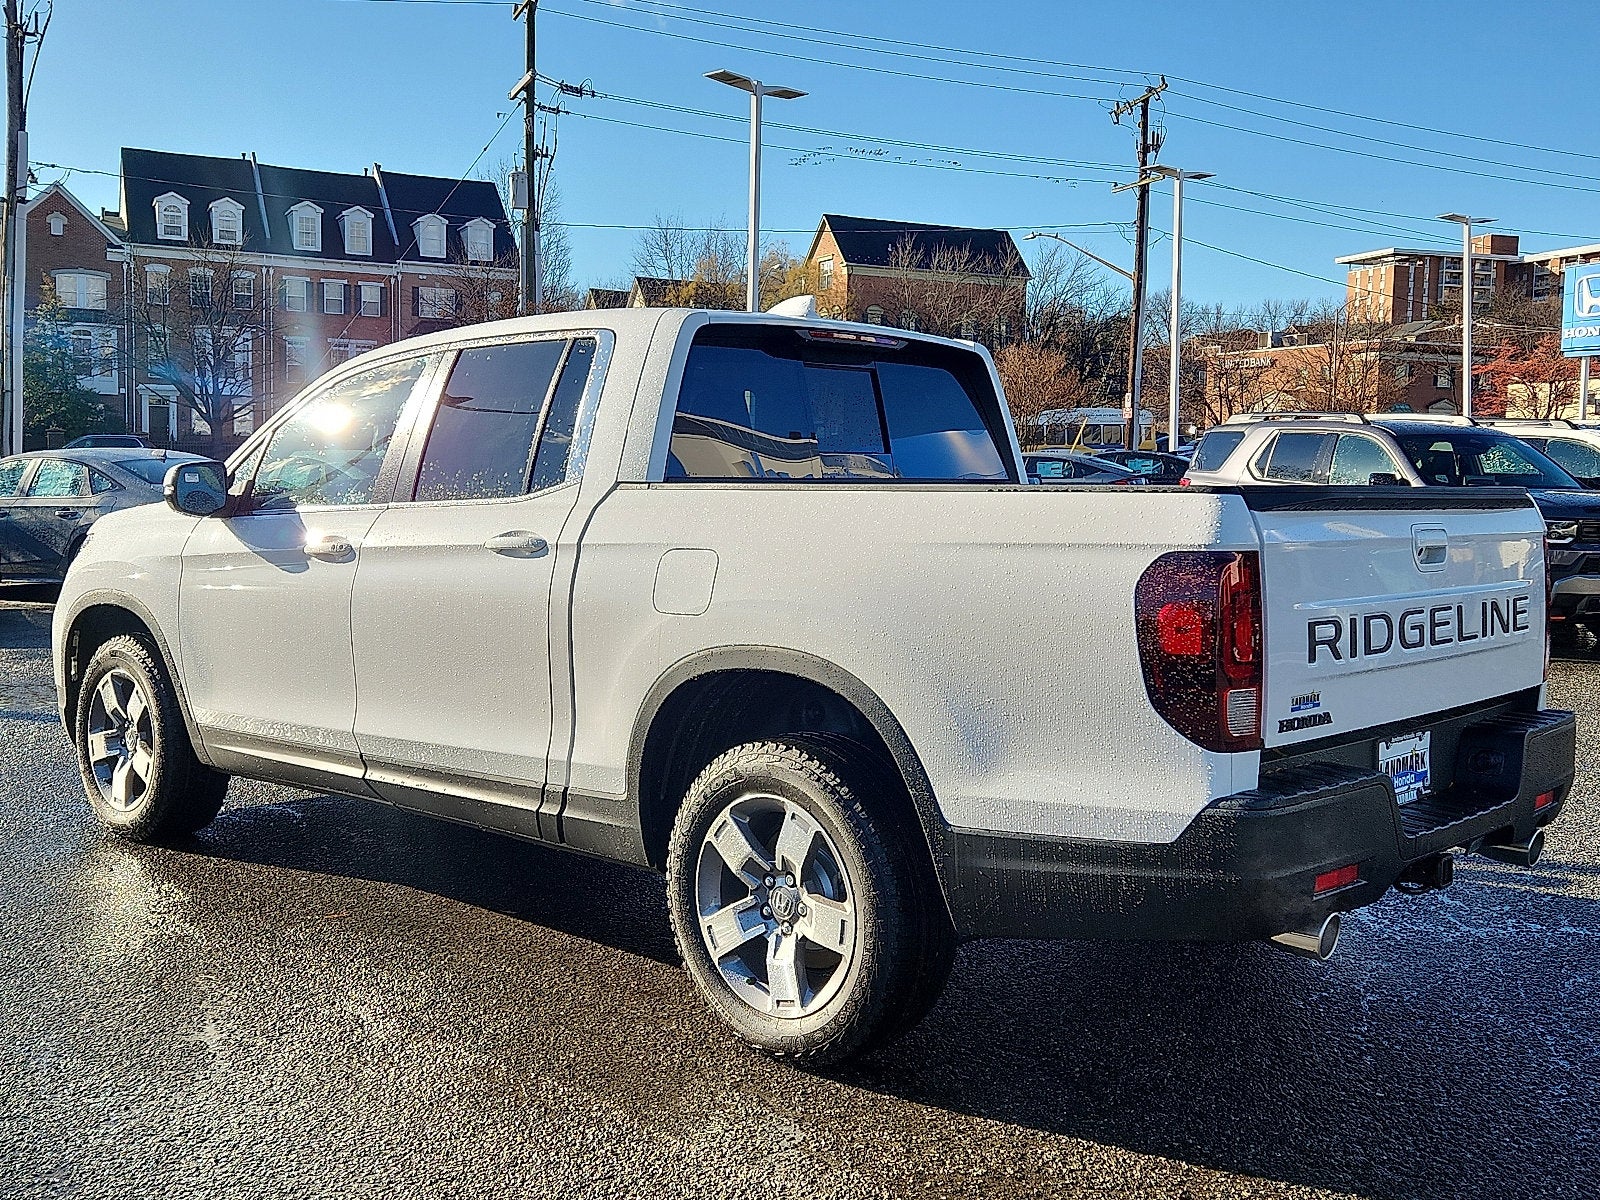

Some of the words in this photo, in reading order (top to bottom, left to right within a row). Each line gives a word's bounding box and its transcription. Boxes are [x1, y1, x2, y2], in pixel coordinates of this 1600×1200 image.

[1249, 356, 1272, 368] BANK
[1306, 594, 1530, 665] RIDGELINE
[1277, 711, 1334, 734] HONDA
[1394, 772, 1415, 789] Honda
